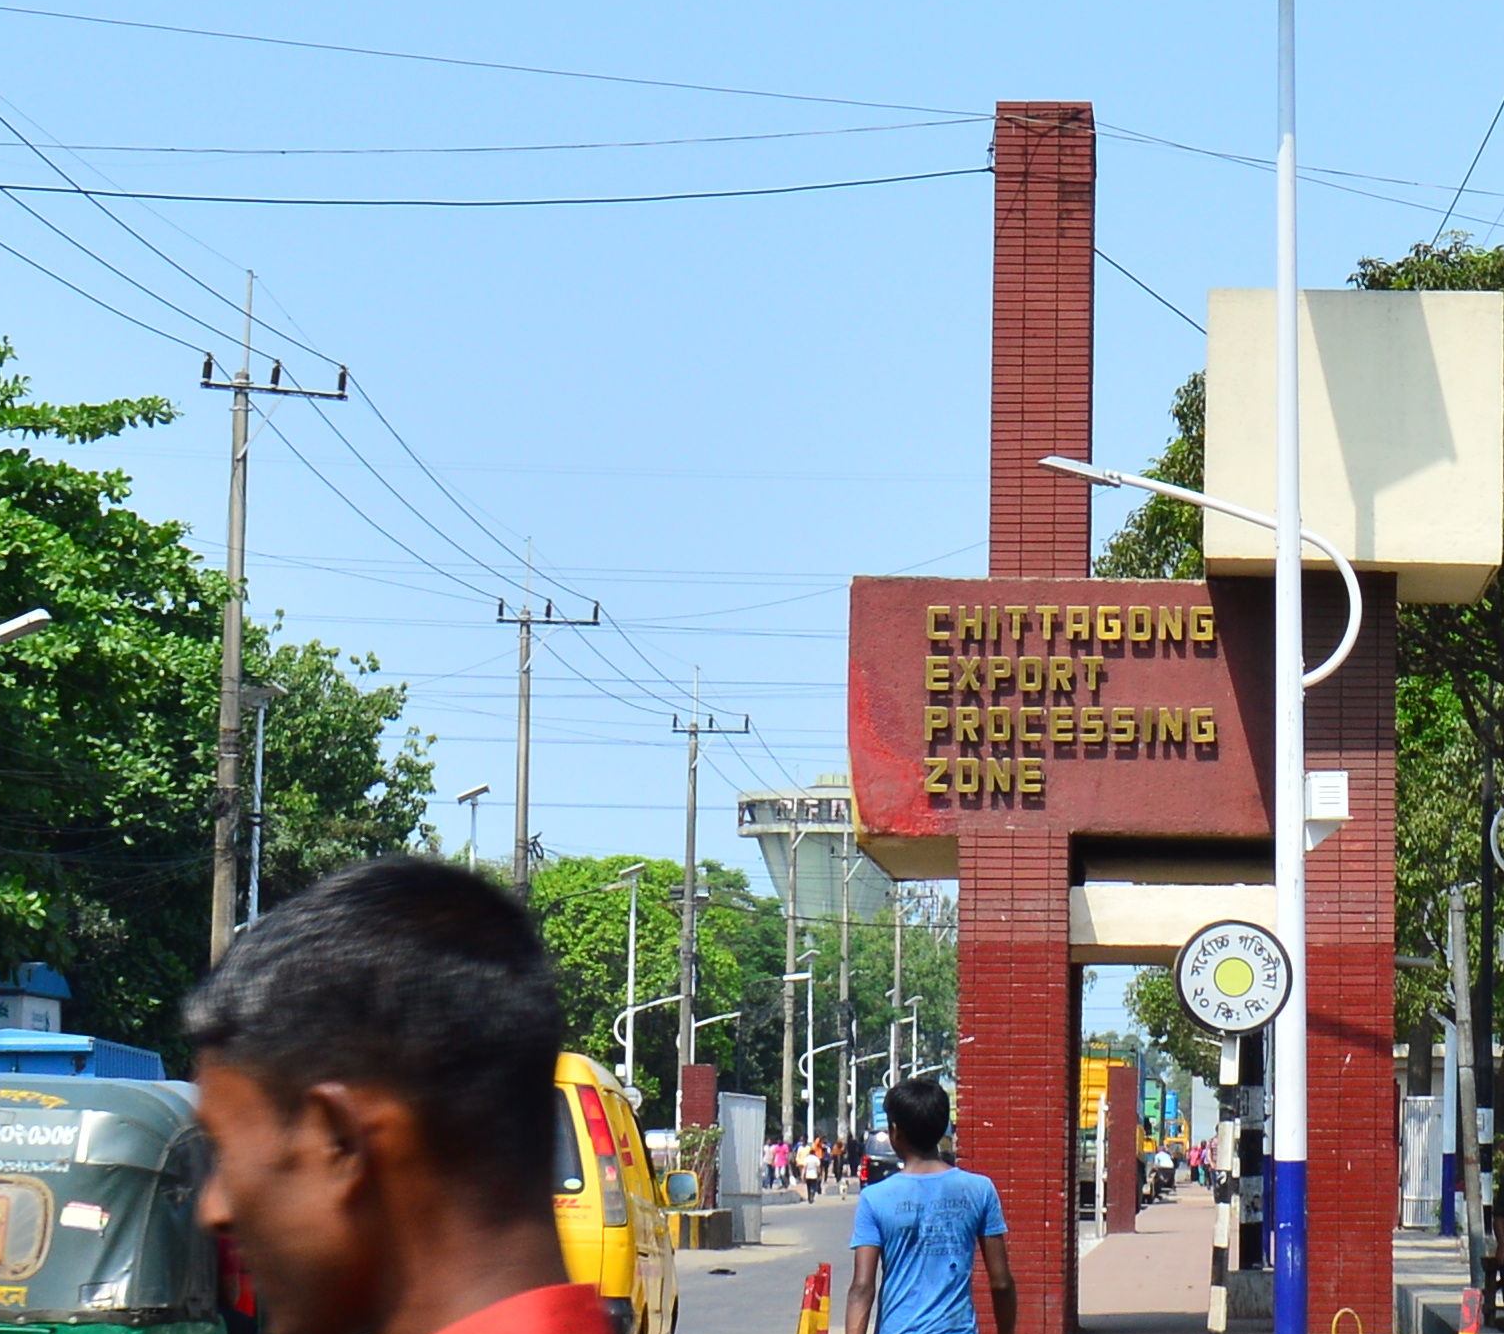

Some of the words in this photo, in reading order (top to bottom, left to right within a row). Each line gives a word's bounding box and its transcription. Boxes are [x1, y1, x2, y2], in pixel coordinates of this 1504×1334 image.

[927, 605, 1214, 641] CHITTAGONG
[925, 656, 1104, 691] EXPORT
[924, 706, 1215, 742] PROCESSING
[924, 758, 1042, 792] ZONE
